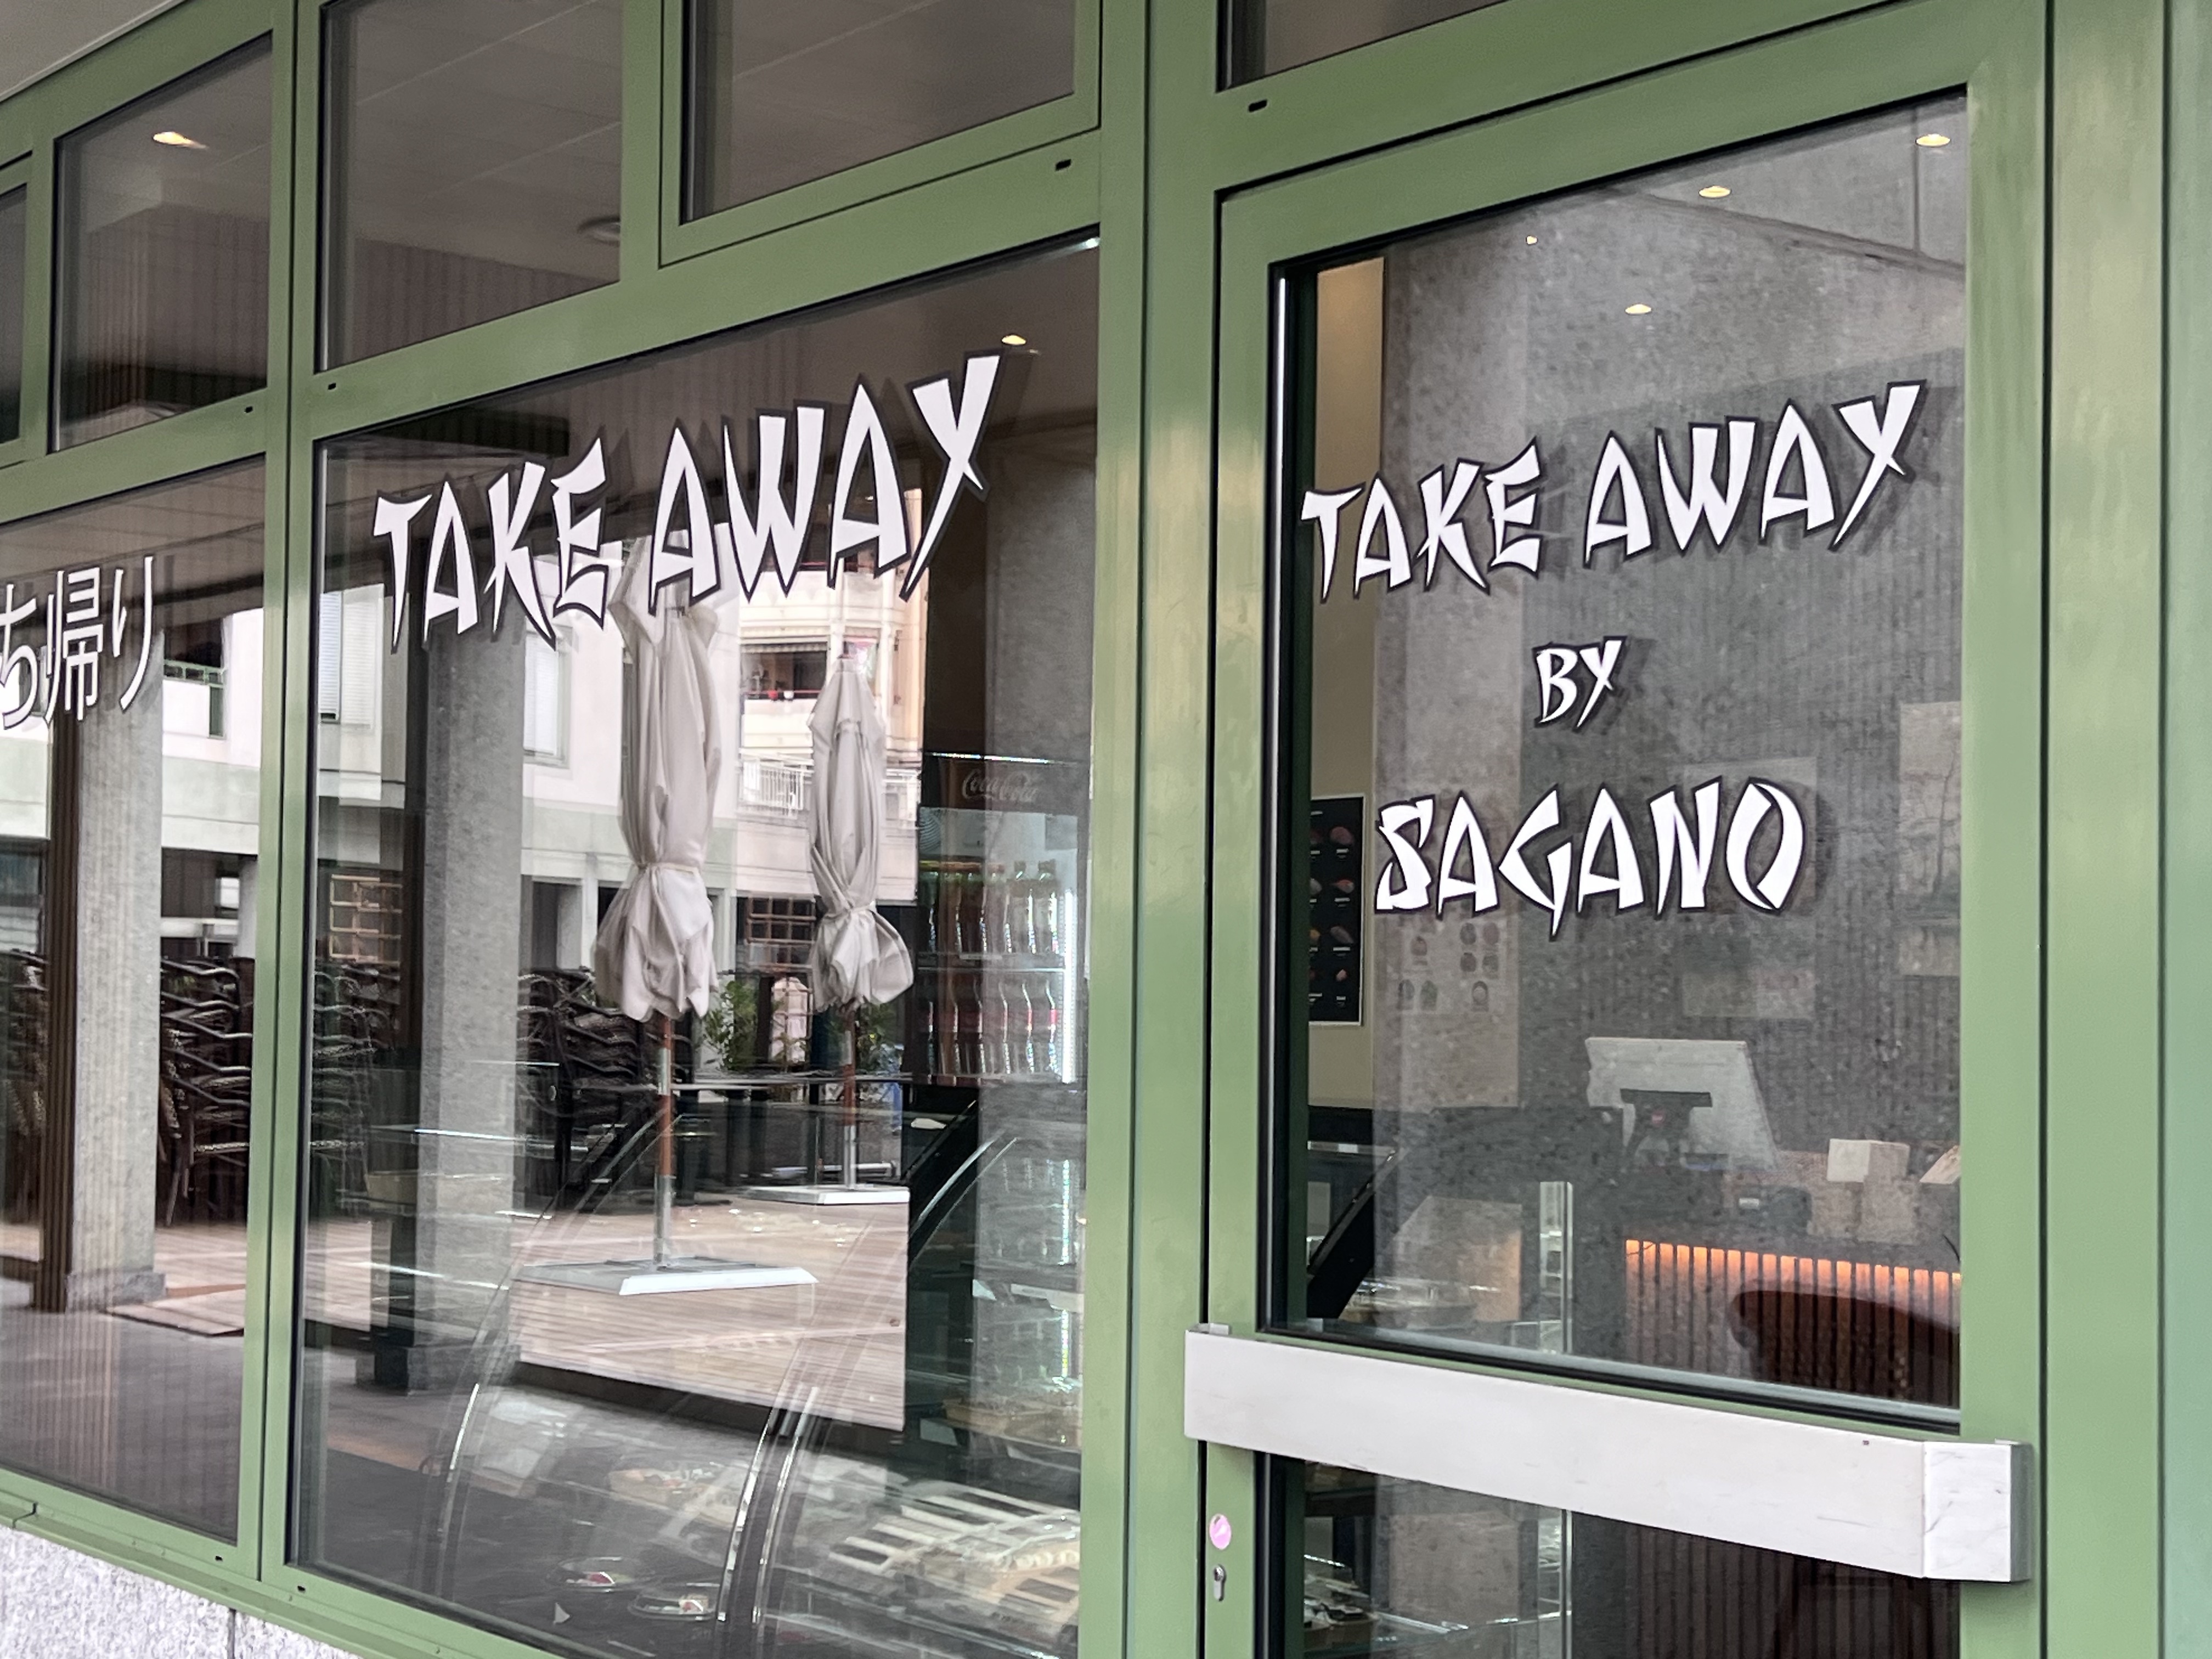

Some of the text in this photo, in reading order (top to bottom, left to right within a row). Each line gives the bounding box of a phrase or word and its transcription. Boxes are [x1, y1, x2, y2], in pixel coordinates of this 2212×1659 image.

[372, 354, 1001, 646] TAKE AWAY
[1300, 383, 1922, 598] TAKE AWAY
[1536, 639, 1623, 727] BY
[1375, 781, 1804, 935] SAGANO
